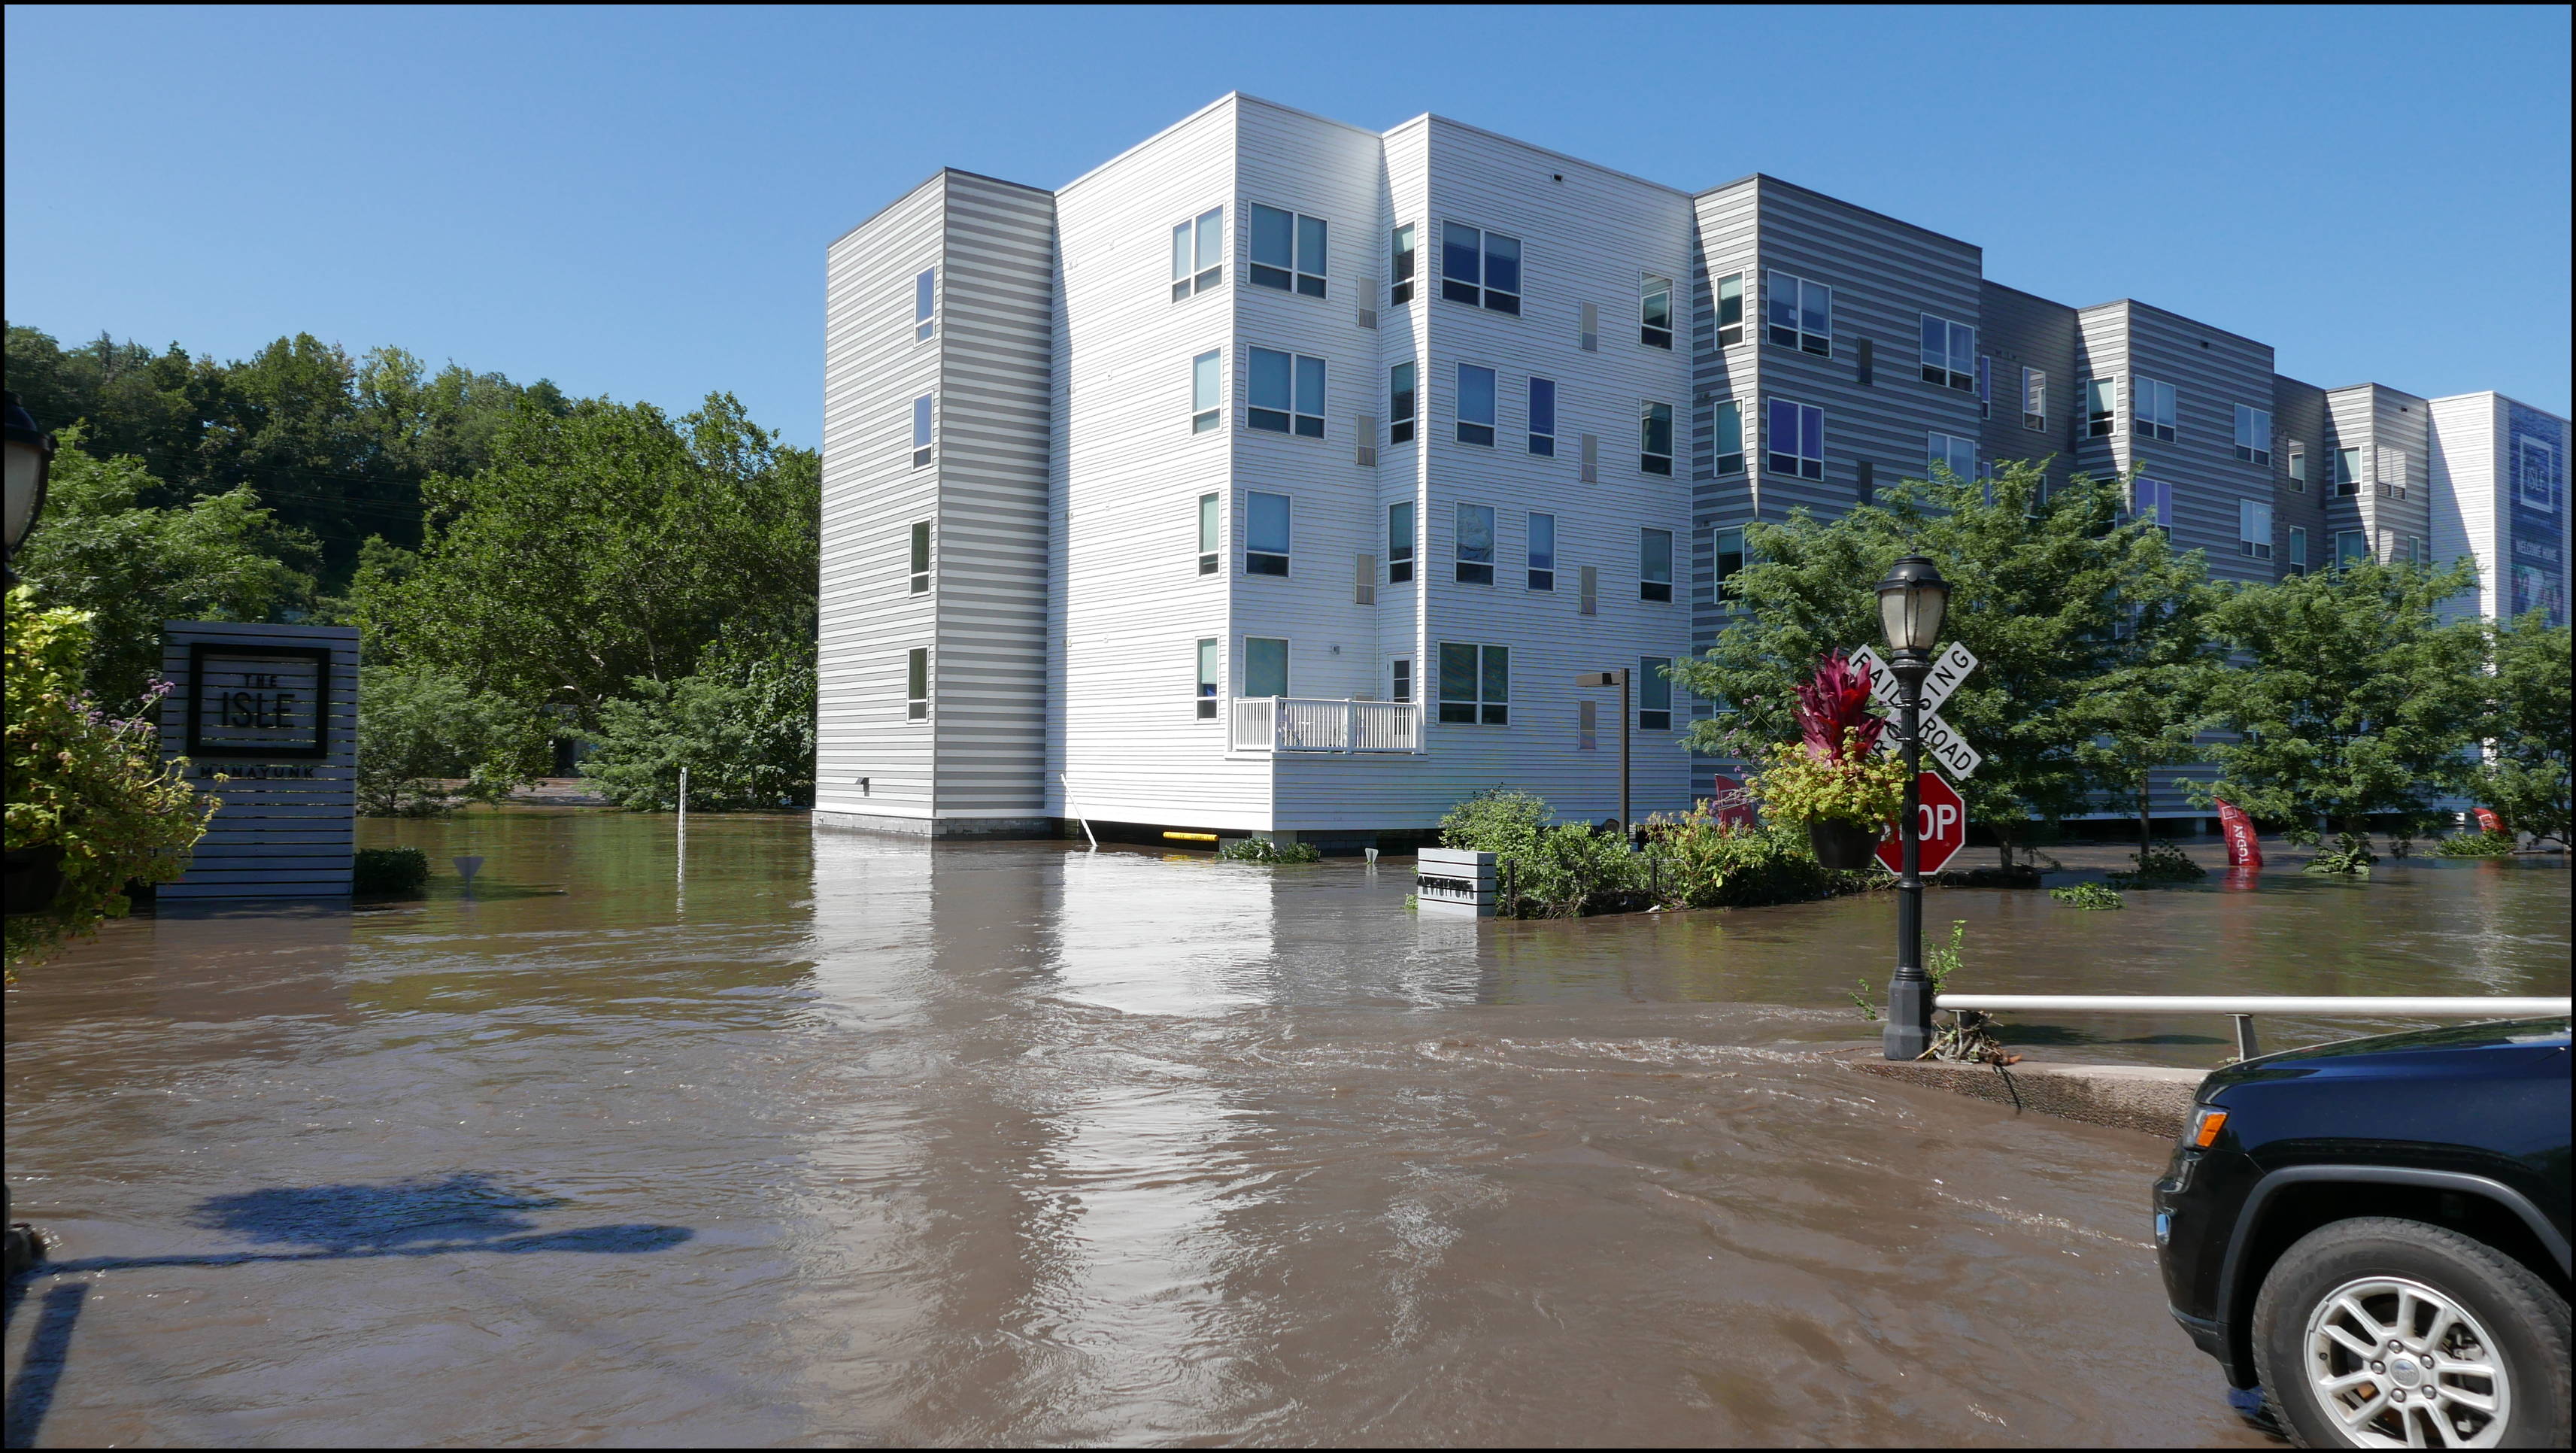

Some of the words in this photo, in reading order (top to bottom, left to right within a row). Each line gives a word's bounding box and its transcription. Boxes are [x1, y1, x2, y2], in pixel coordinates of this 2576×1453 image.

[244, 675, 278, 687] THE
[222, 691, 296, 728] ISLE
[1880, 803, 1957, 842] OP
[2232, 824, 2250, 865] TODAY
